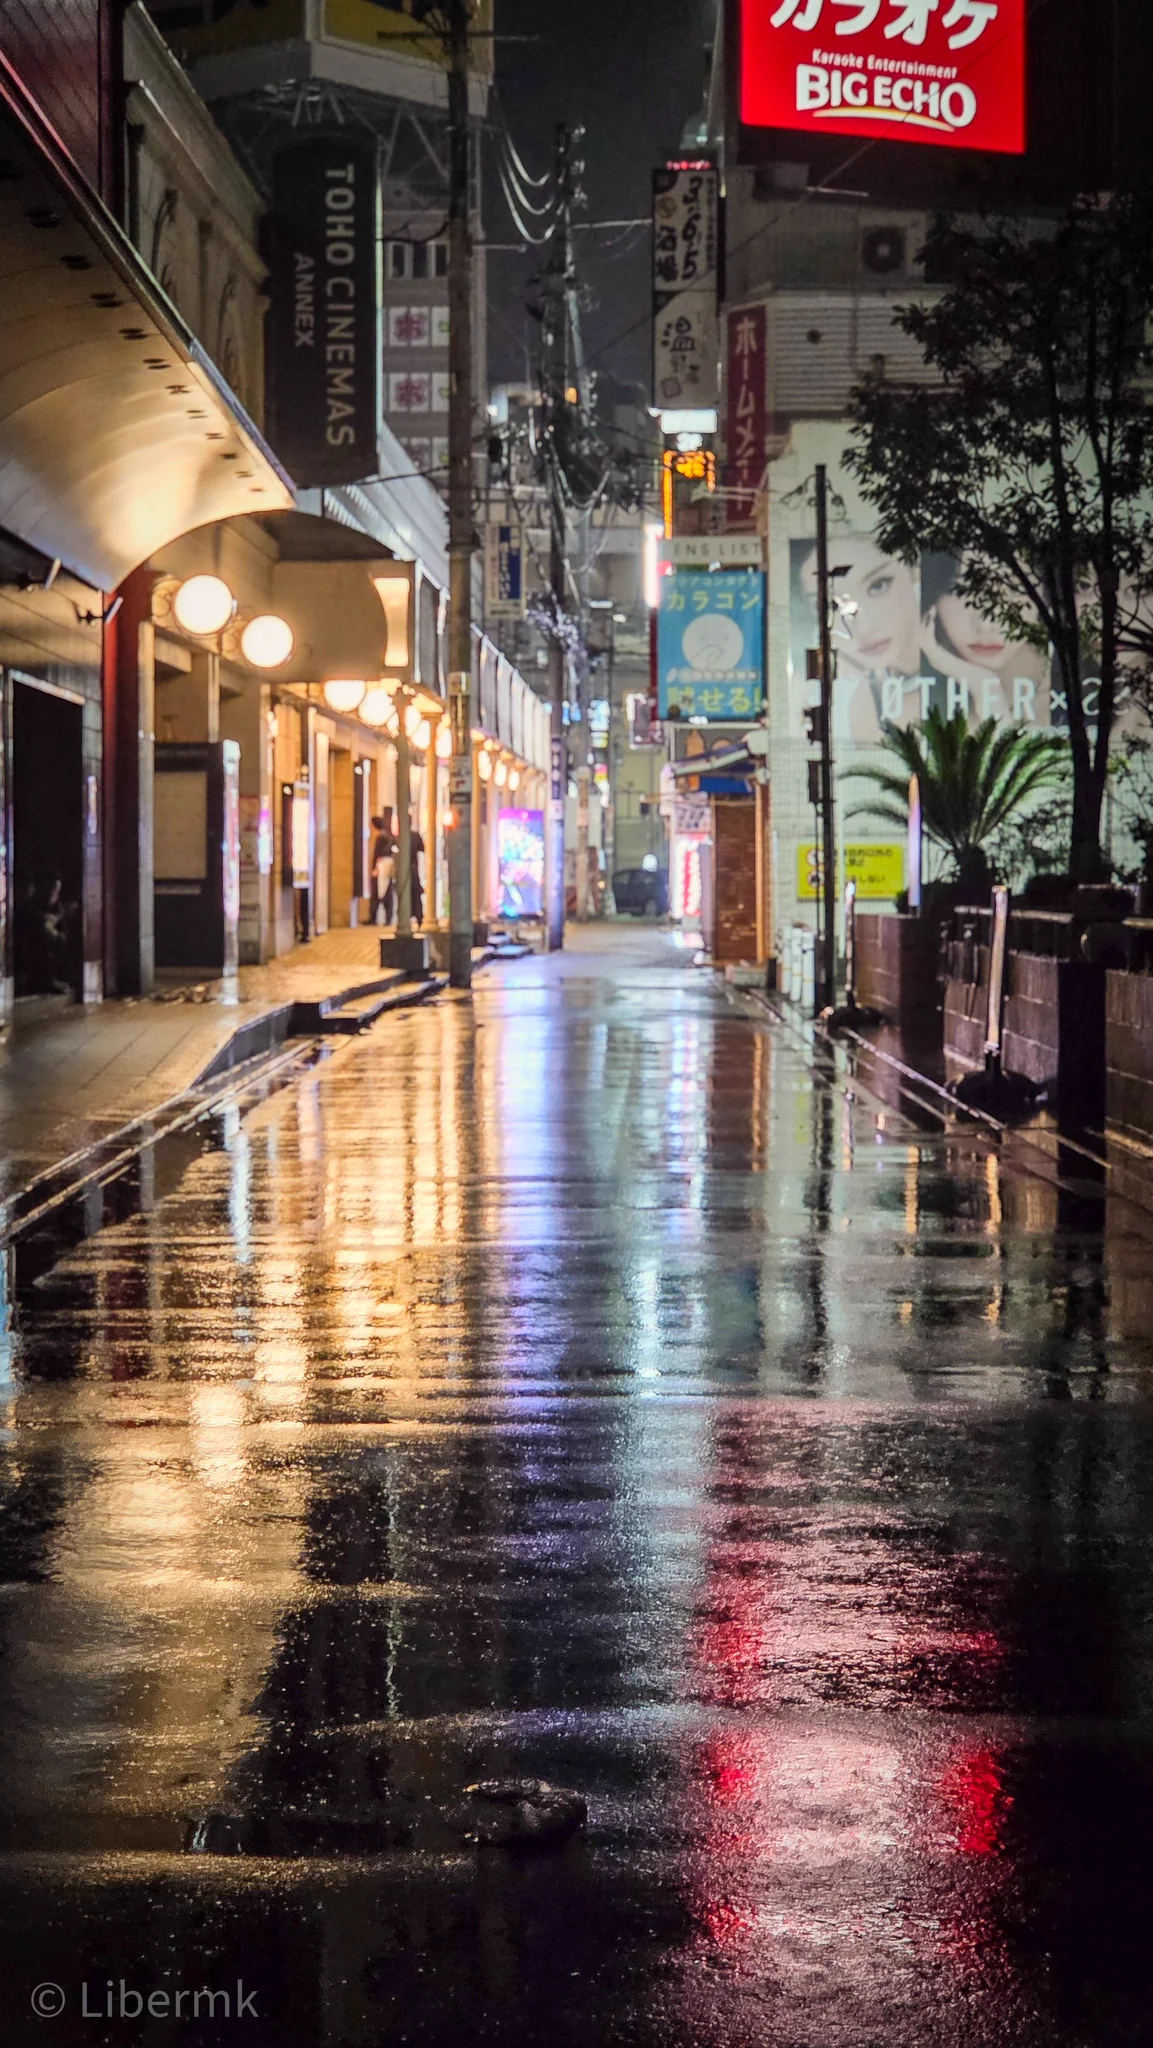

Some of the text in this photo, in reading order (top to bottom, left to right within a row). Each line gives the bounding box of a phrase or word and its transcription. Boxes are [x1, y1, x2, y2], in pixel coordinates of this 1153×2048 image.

[770, 0, 998, 50] カラオケ
[812, 48, 958, 79] Karaoke Entertainment
[796, 63, 977, 127] BIG ECHO
[293, 252, 316, 348] ANNEX
[325, 164, 355, 446] TOHO CINEMAS
[719, 543, 760, 556] LIST
[666, 590, 761, 611] カラコン
